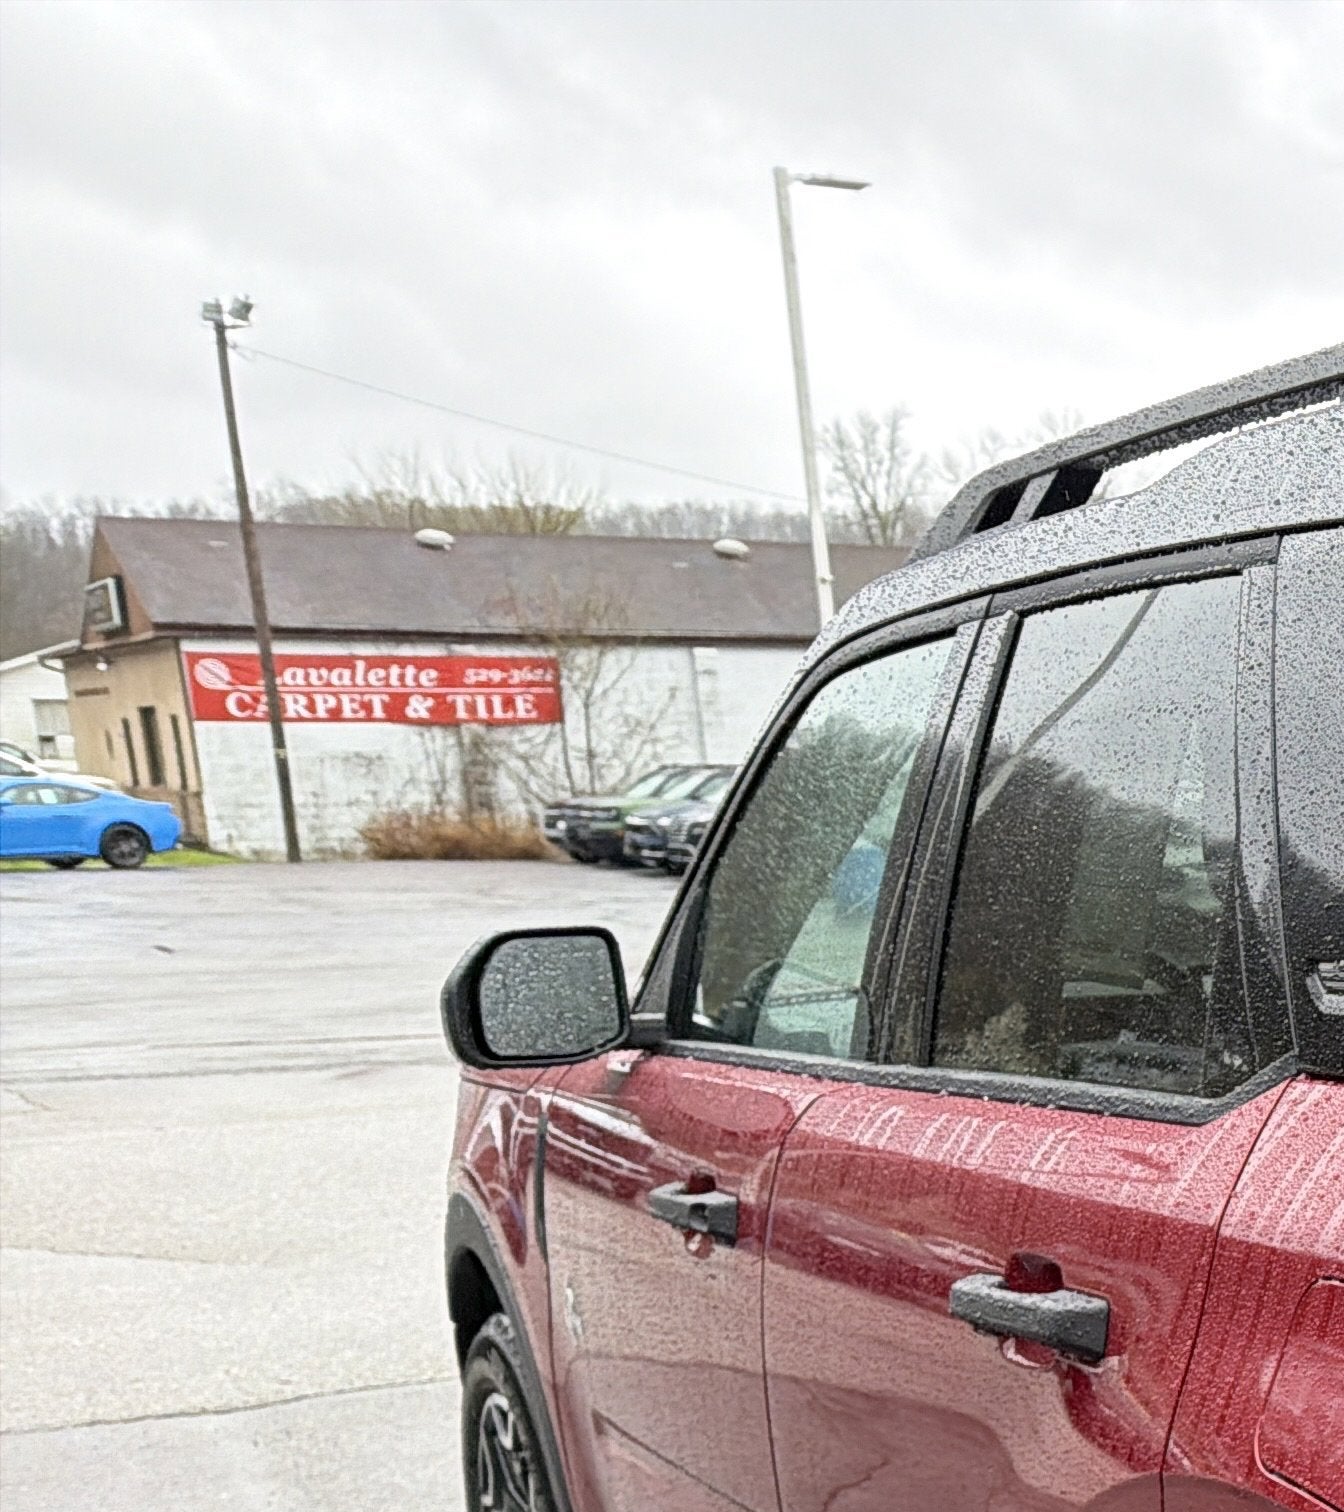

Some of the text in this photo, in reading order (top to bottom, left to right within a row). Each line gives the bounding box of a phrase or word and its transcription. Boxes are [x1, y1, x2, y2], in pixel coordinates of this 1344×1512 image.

[256, 659, 438, 687] avalette
[404, 694, 434, 719] &
[446, 694, 538, 719] TILE
